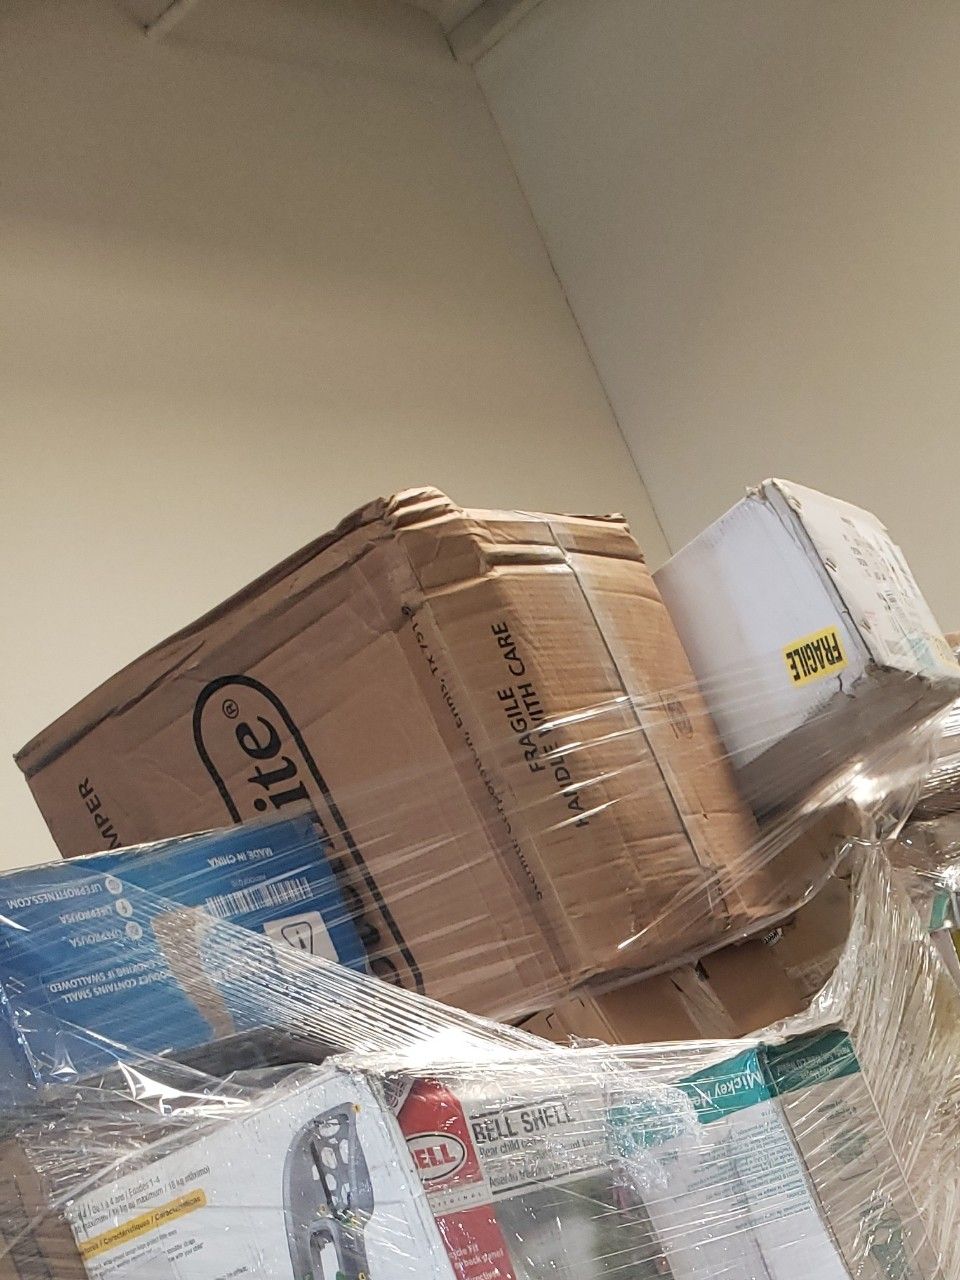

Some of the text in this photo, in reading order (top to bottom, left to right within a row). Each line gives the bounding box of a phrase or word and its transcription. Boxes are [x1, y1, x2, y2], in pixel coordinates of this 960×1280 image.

[490, 620, 526, 678] CARE
[785, 632, 842, 681] FRAGILE
[424, 654, 441, 677] TX
[496, 686, 545, 773] FRAGILE
[207, 847, 273, 867] MADE IN CHINA
[61, 978, 137, 1002] CONTAINS SMALL
[711, 1070, 762, 1098] Mickey
[471, 1112, 518, 1145] BELL
[520, 1100, 576, 1133] SHELL
[410, 1142, 456, 1170] ELL
